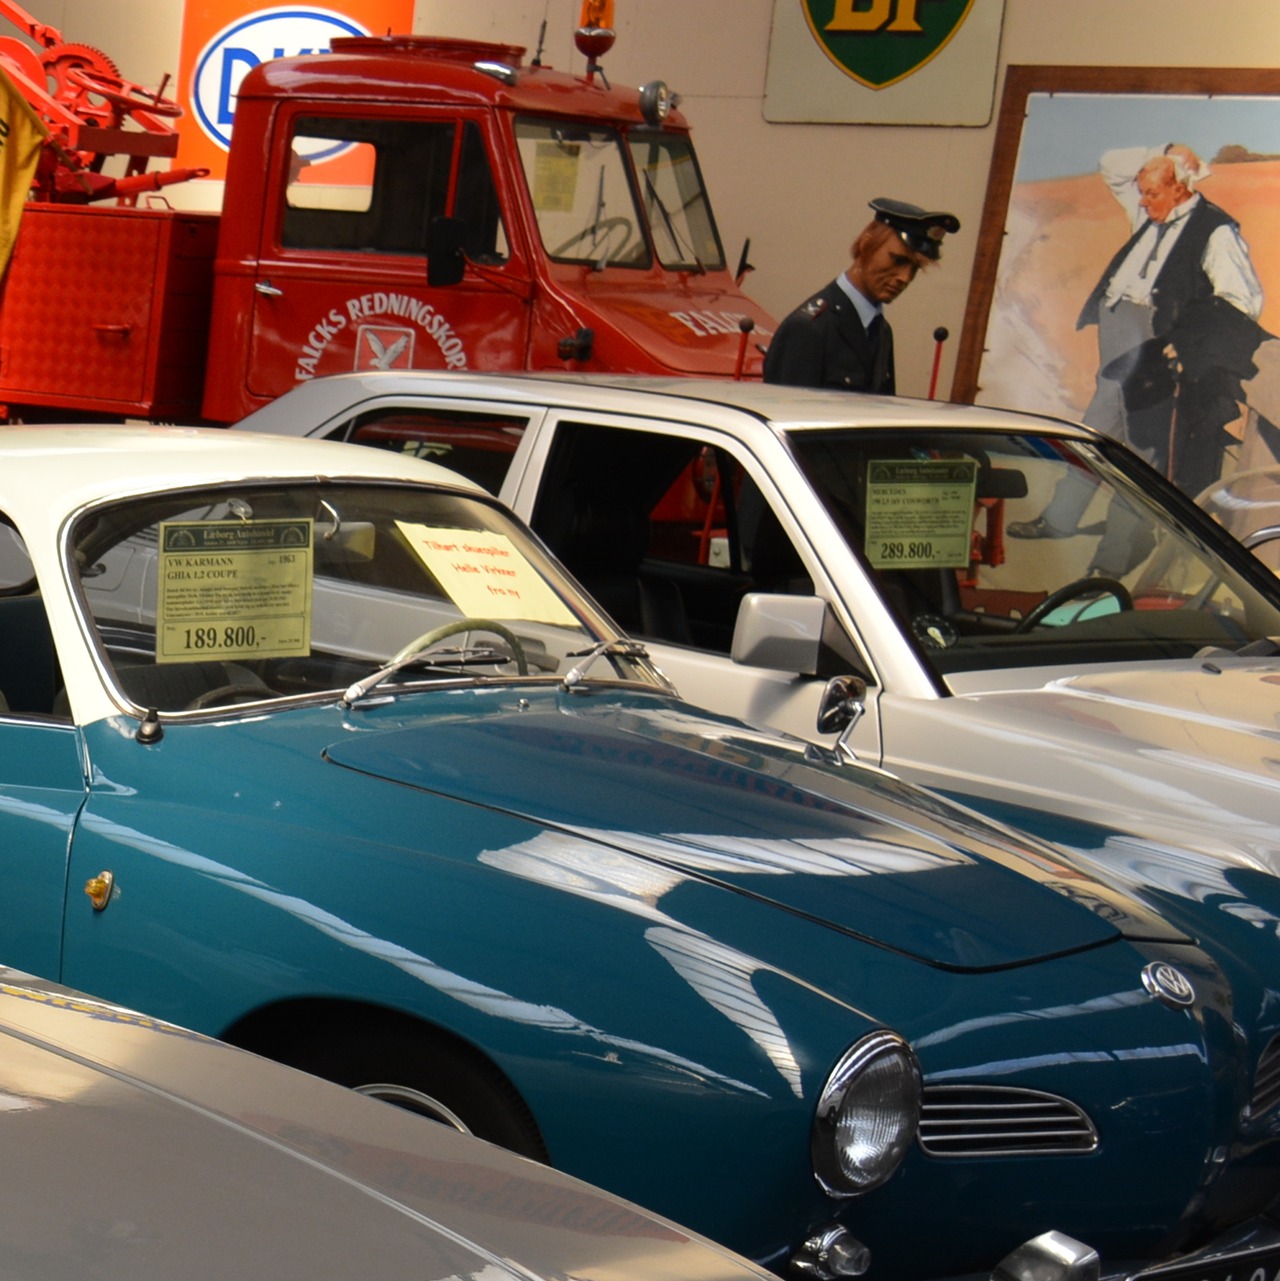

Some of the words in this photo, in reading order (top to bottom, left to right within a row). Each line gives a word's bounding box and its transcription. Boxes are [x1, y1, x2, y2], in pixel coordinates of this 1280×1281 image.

[295, 308, 347, 381] FALCKS
[346, 292, 468, 371] REDNINGSKOR
[168, 559, 185, 568] VW
[186, 557, 233, 567] KARMANN
[167, 571, 191, 580] GHIA
[206, 569, 238, 579] COUPE
[184, 625, 266, 649] 189.800,-
